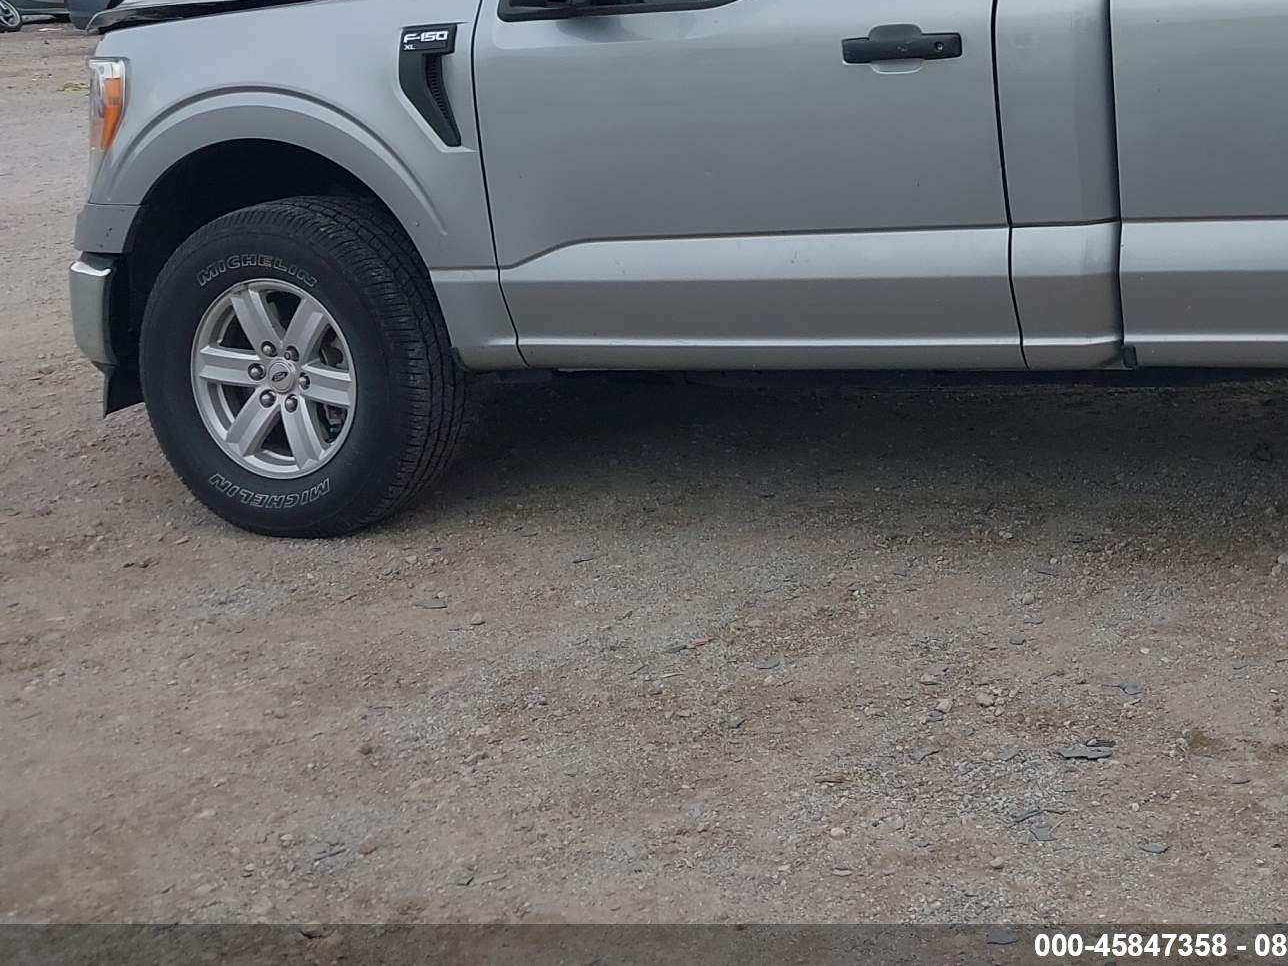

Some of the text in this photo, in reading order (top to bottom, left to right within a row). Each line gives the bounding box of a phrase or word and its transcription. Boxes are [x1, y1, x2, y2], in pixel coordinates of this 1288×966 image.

[403, 30, 449, 43] F-150
[197, 253, 317, 287] MICHELIN
[209, 473, 330, 509] MICHELIN
